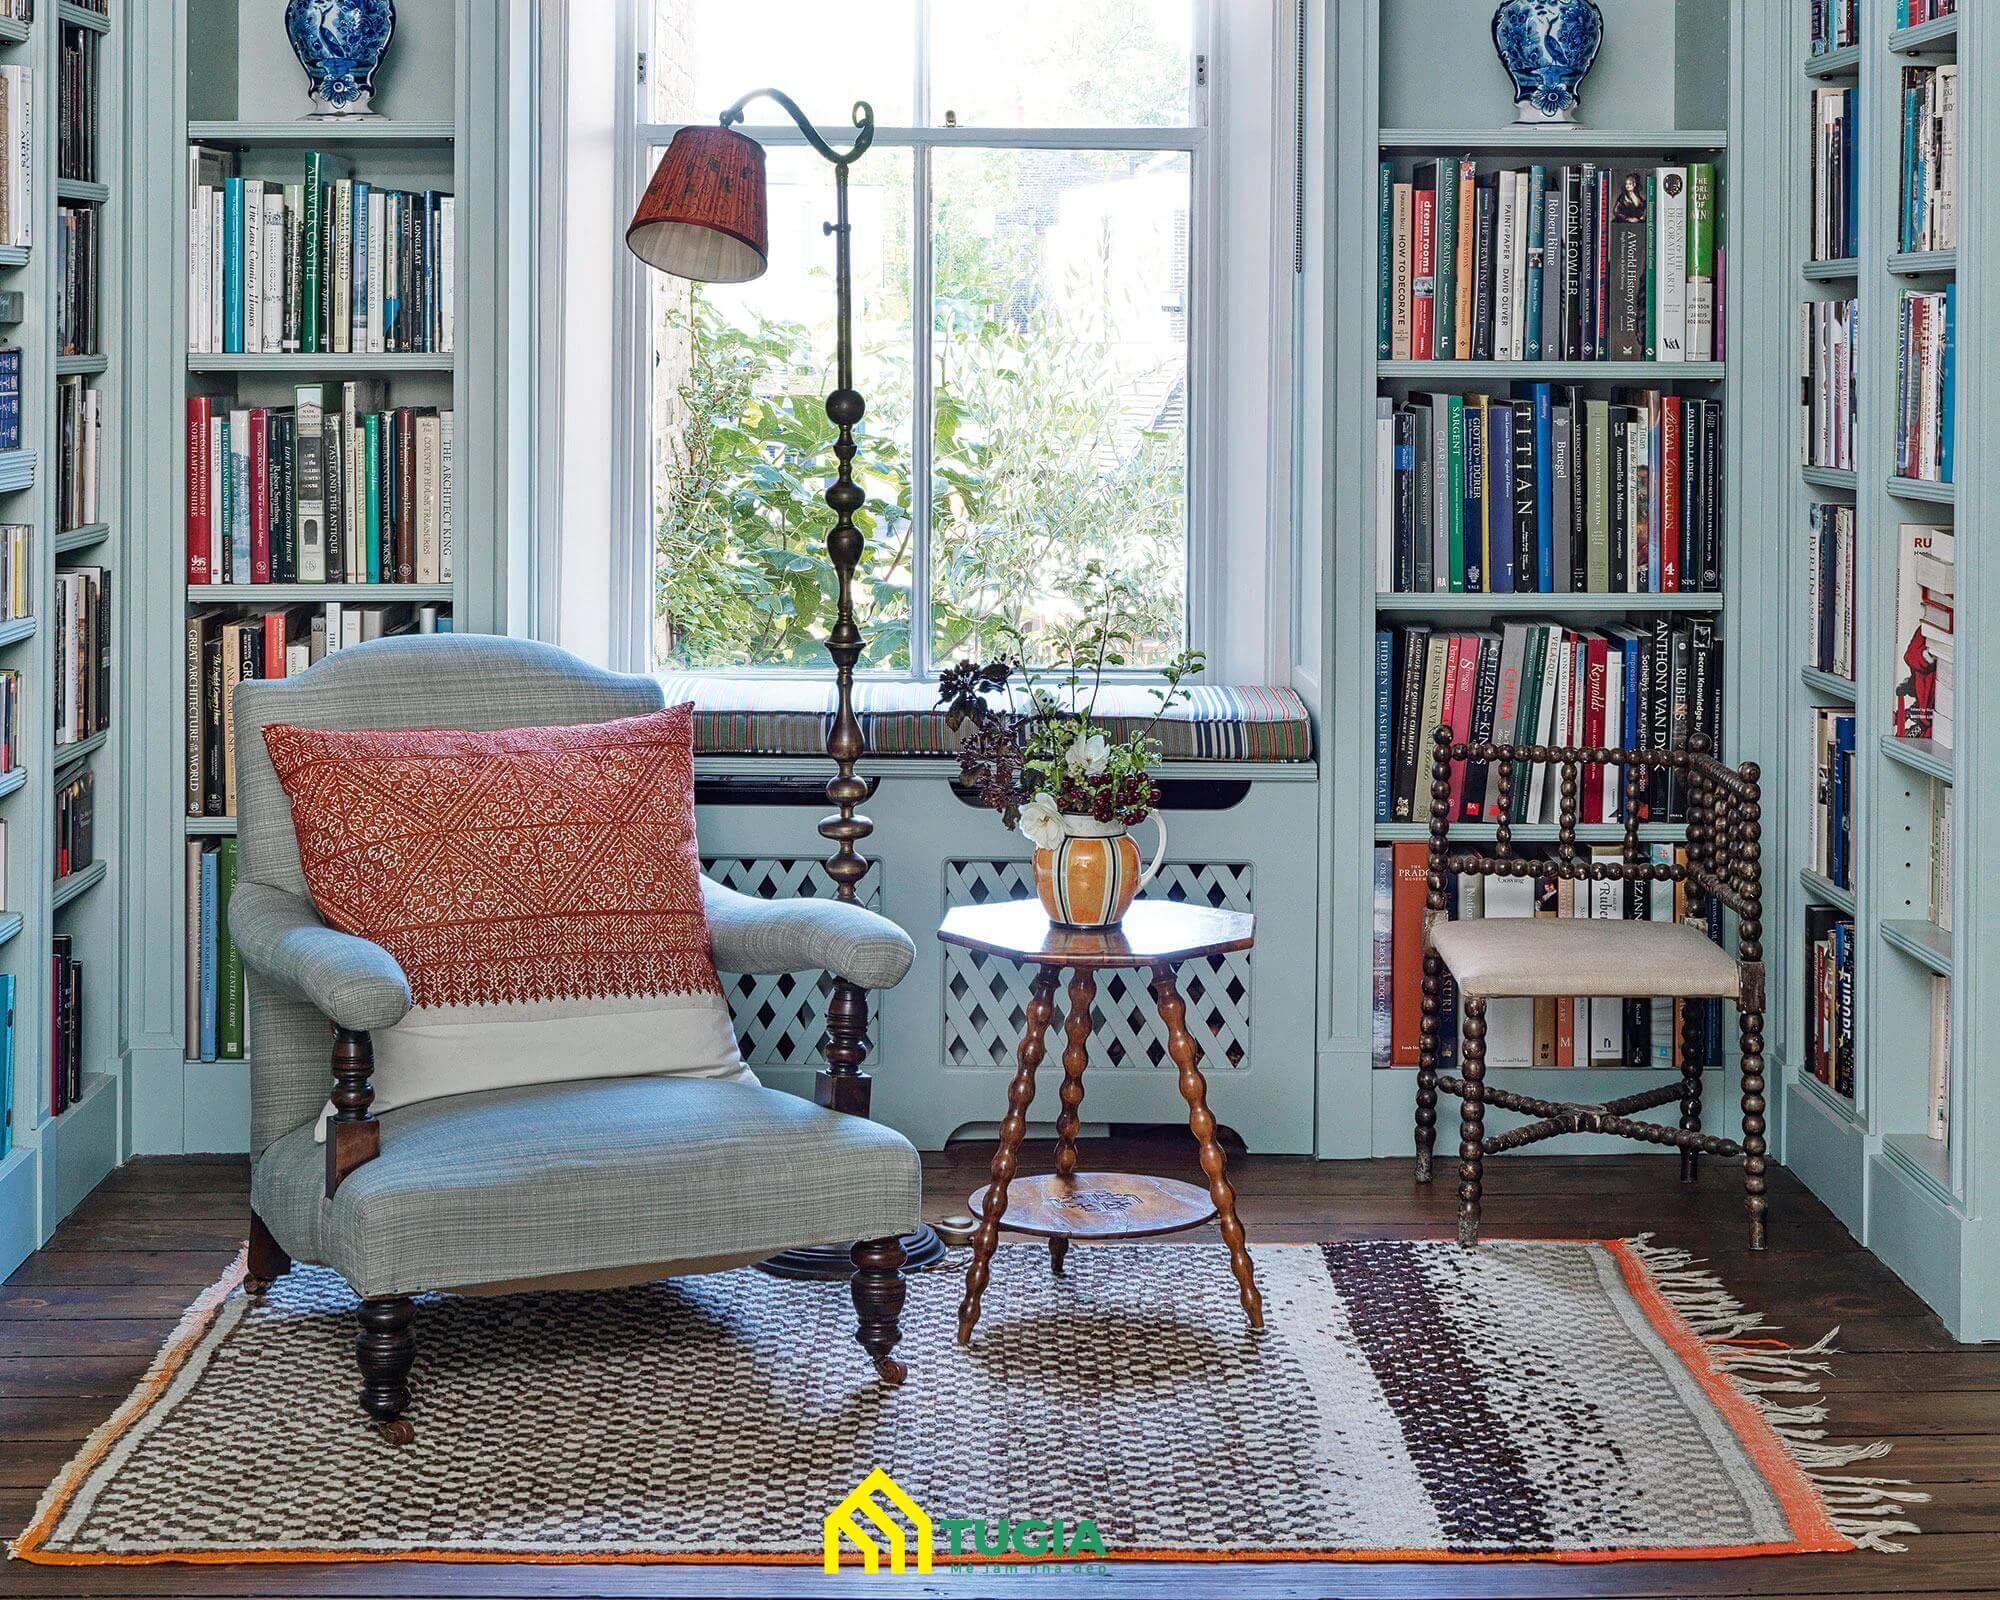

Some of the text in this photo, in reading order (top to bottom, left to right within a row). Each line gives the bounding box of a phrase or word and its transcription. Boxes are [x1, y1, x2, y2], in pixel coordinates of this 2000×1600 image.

[1443, 207, 1452, 220] ON
[1534, 174, 1543, 201] English
[306, 165, 317, 281] ALNWICK CASTLE
[359, 202, 367, 257] BURGHLEY
[1382, 217, 1390, 244] LIVING
[1423, 200, 1432, 236] dream
[1547, 199, 1559, 266] Robert Kime
[1675, 207, 1683, 271] DESIGN THE
[247, 204, 258, 327] The Last Country Houses
[369, 226, 377, 310] CASTLE HOWARD
[1443, 222, 1452, 275] DECORATING
[1463, 223, 1471, 269] DECORATION
[1479, 214, 1489, 323] THE DRAWING ROOM
[1501, 204, 1512, 326] PAINT PAPER DAVID OLIVER
[1567, 200, 1578, 295] JOHN FOWLER
[1627, 241, 1636, 268] World
[1667, 207, 1675, 295] DECORATIVE ARTS
[1398, 234, 1406, 325] HOW TO DECORATE
[1625, 270, 1636, 304] History
[1626, 316, 1636, 332] Art
[1627, 305, 1636, 315] of
[1663, 337, 1681, 350] V&A
[1437, 430, 1445, 479] CHARLES
[1452, 406, 1460, 456] SARGENT
[1639, 427, 1647, 449] Titian
[1687, 408, 1695, 447] PAINTED
[329, 444, 337, 471] TASTE
[329, 472, 337, 492] AND
[1472, 418, 1481, 499] GIOTTO DÜRER
[1515, 407, 1533, 516] TITIAN
[1554, 441, 1566, 478] Bruegel
[1616, 446, 1624, 520] Antonello da Messina
[1686, 450, 1694, 481] LADIES
[273, 491, 281, 524] Smythson
[423, 437, 431, 555] COUNTRY HOUSE TREASURES
[443, 440, 452, 556] THE ARCHITECT KING
[1665, 458, 1676, 529] COLLECTION
[330, 513, 338, 554] ANTIQUE
[1809, 536, 1817, 596] BERLIN
[213, 654, 221, 666] The
[1431, 645, 1444, 699] THE GENIUS
[1443, 645, 1458, 711] Peter Paul Rubens
[1545, 635, 1559, 687] VELÁZQUEZ
[1560, 646, 1568, 694] LEONARDO
[1628, 651, 1637, 693] Impression
[189, 629, 199, 791] GREAT ARCHITECTURE WORLD
[226, 665, 235, 711] ANCESTRAL
[1406, 638, 1423, 766] GEORGE III QUEEN CHARLOTTE
[1475, 647, 1499, 765] CITIZENS KINS
[1501, 666, 1520, 721] CHINA
[1559, 696, 1566, 706] DA
[1589, 663, 1605, 712] Reynolds
[1639, 655, 1650, 752] Sotheby's ART AT AUCTIO
[1654, 619, 1668, 771] ANTHONY VAN DYK
[1675, 667, 1688, 721] RUBENS
[1694, 651, 1706, 732] Secret Knowledge by
[1378, 640, 1389, 816] HIDDEN TREASURES REVEALED
